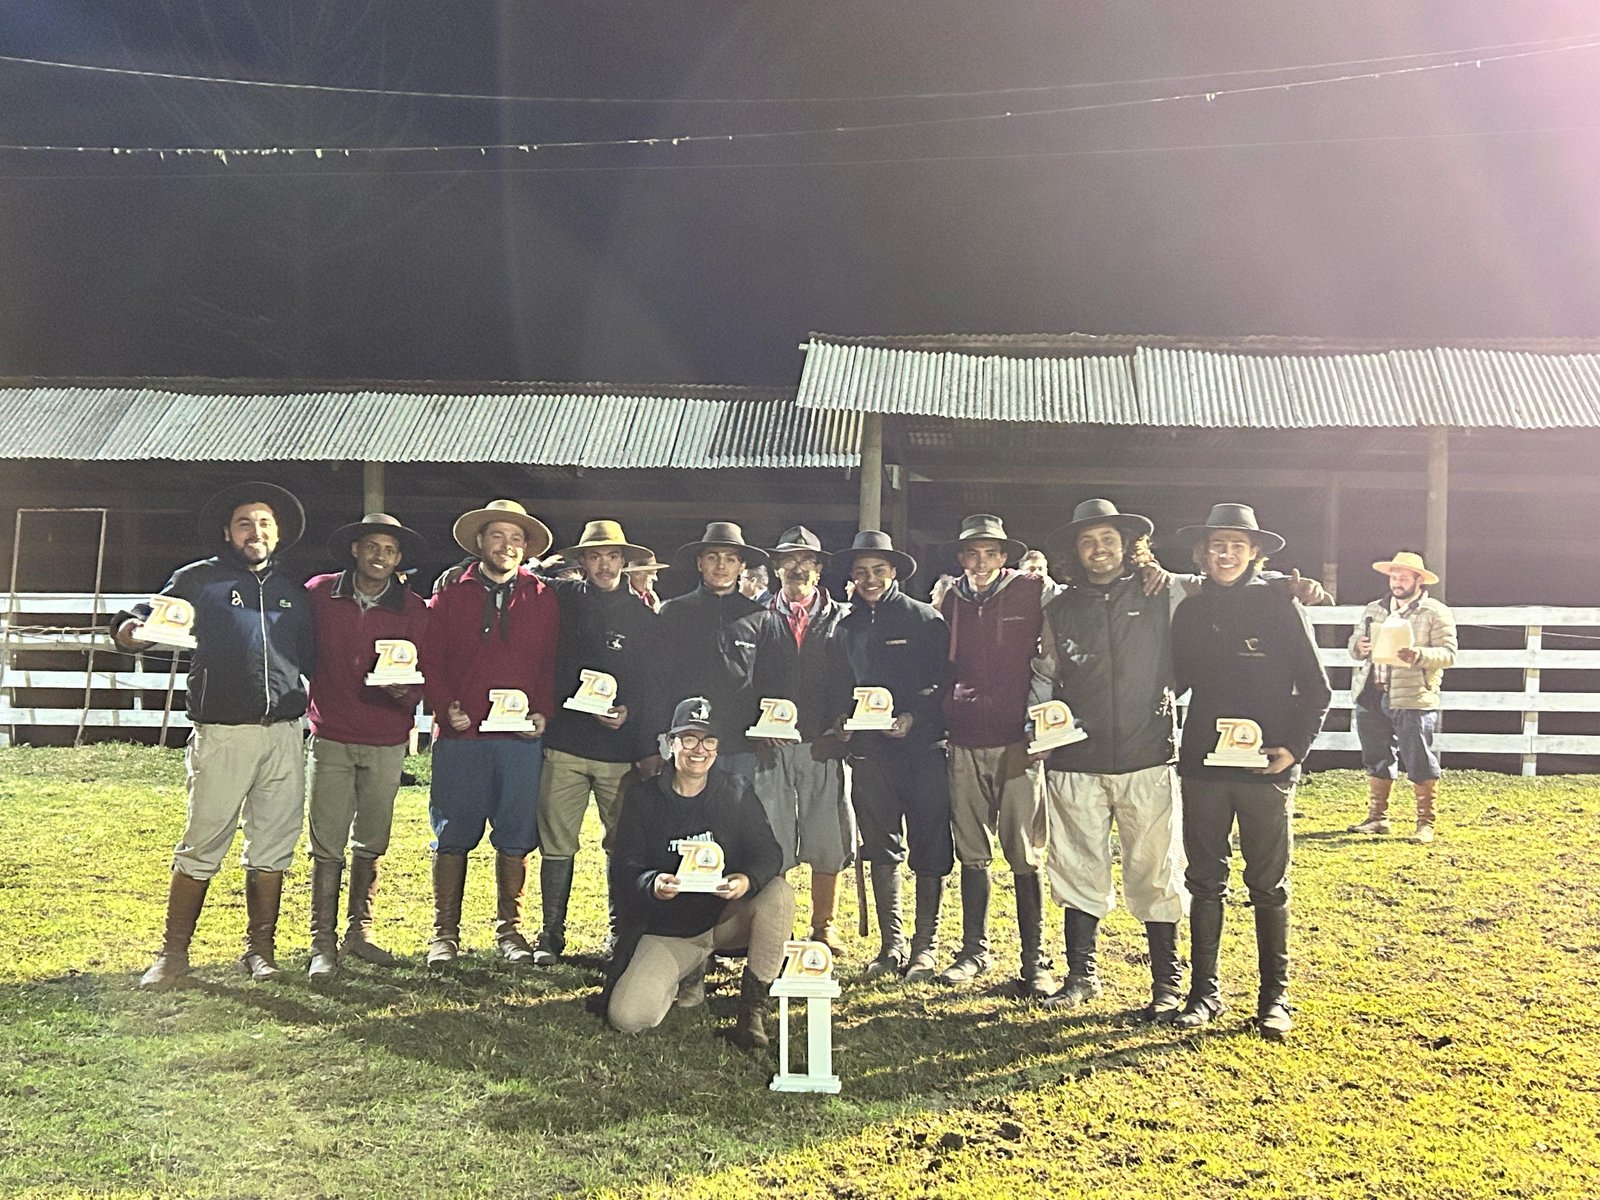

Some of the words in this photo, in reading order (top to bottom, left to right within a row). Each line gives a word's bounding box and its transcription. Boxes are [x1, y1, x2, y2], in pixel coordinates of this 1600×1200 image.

[147, 598, 192, 628] 70
[377, 642, 415, 669] 70
[578, 672, 615, 700] 70
[489, 692, 527, 718] 70
[760, 700, 795, 725] 70
[855, 689, 891, 715] 70
[1030, 703, 1069, 735] 70
[1217, 721, 1259, 751] 70
[679, 843, 721, 874] 70
[785, 943, 830, 977] 70
